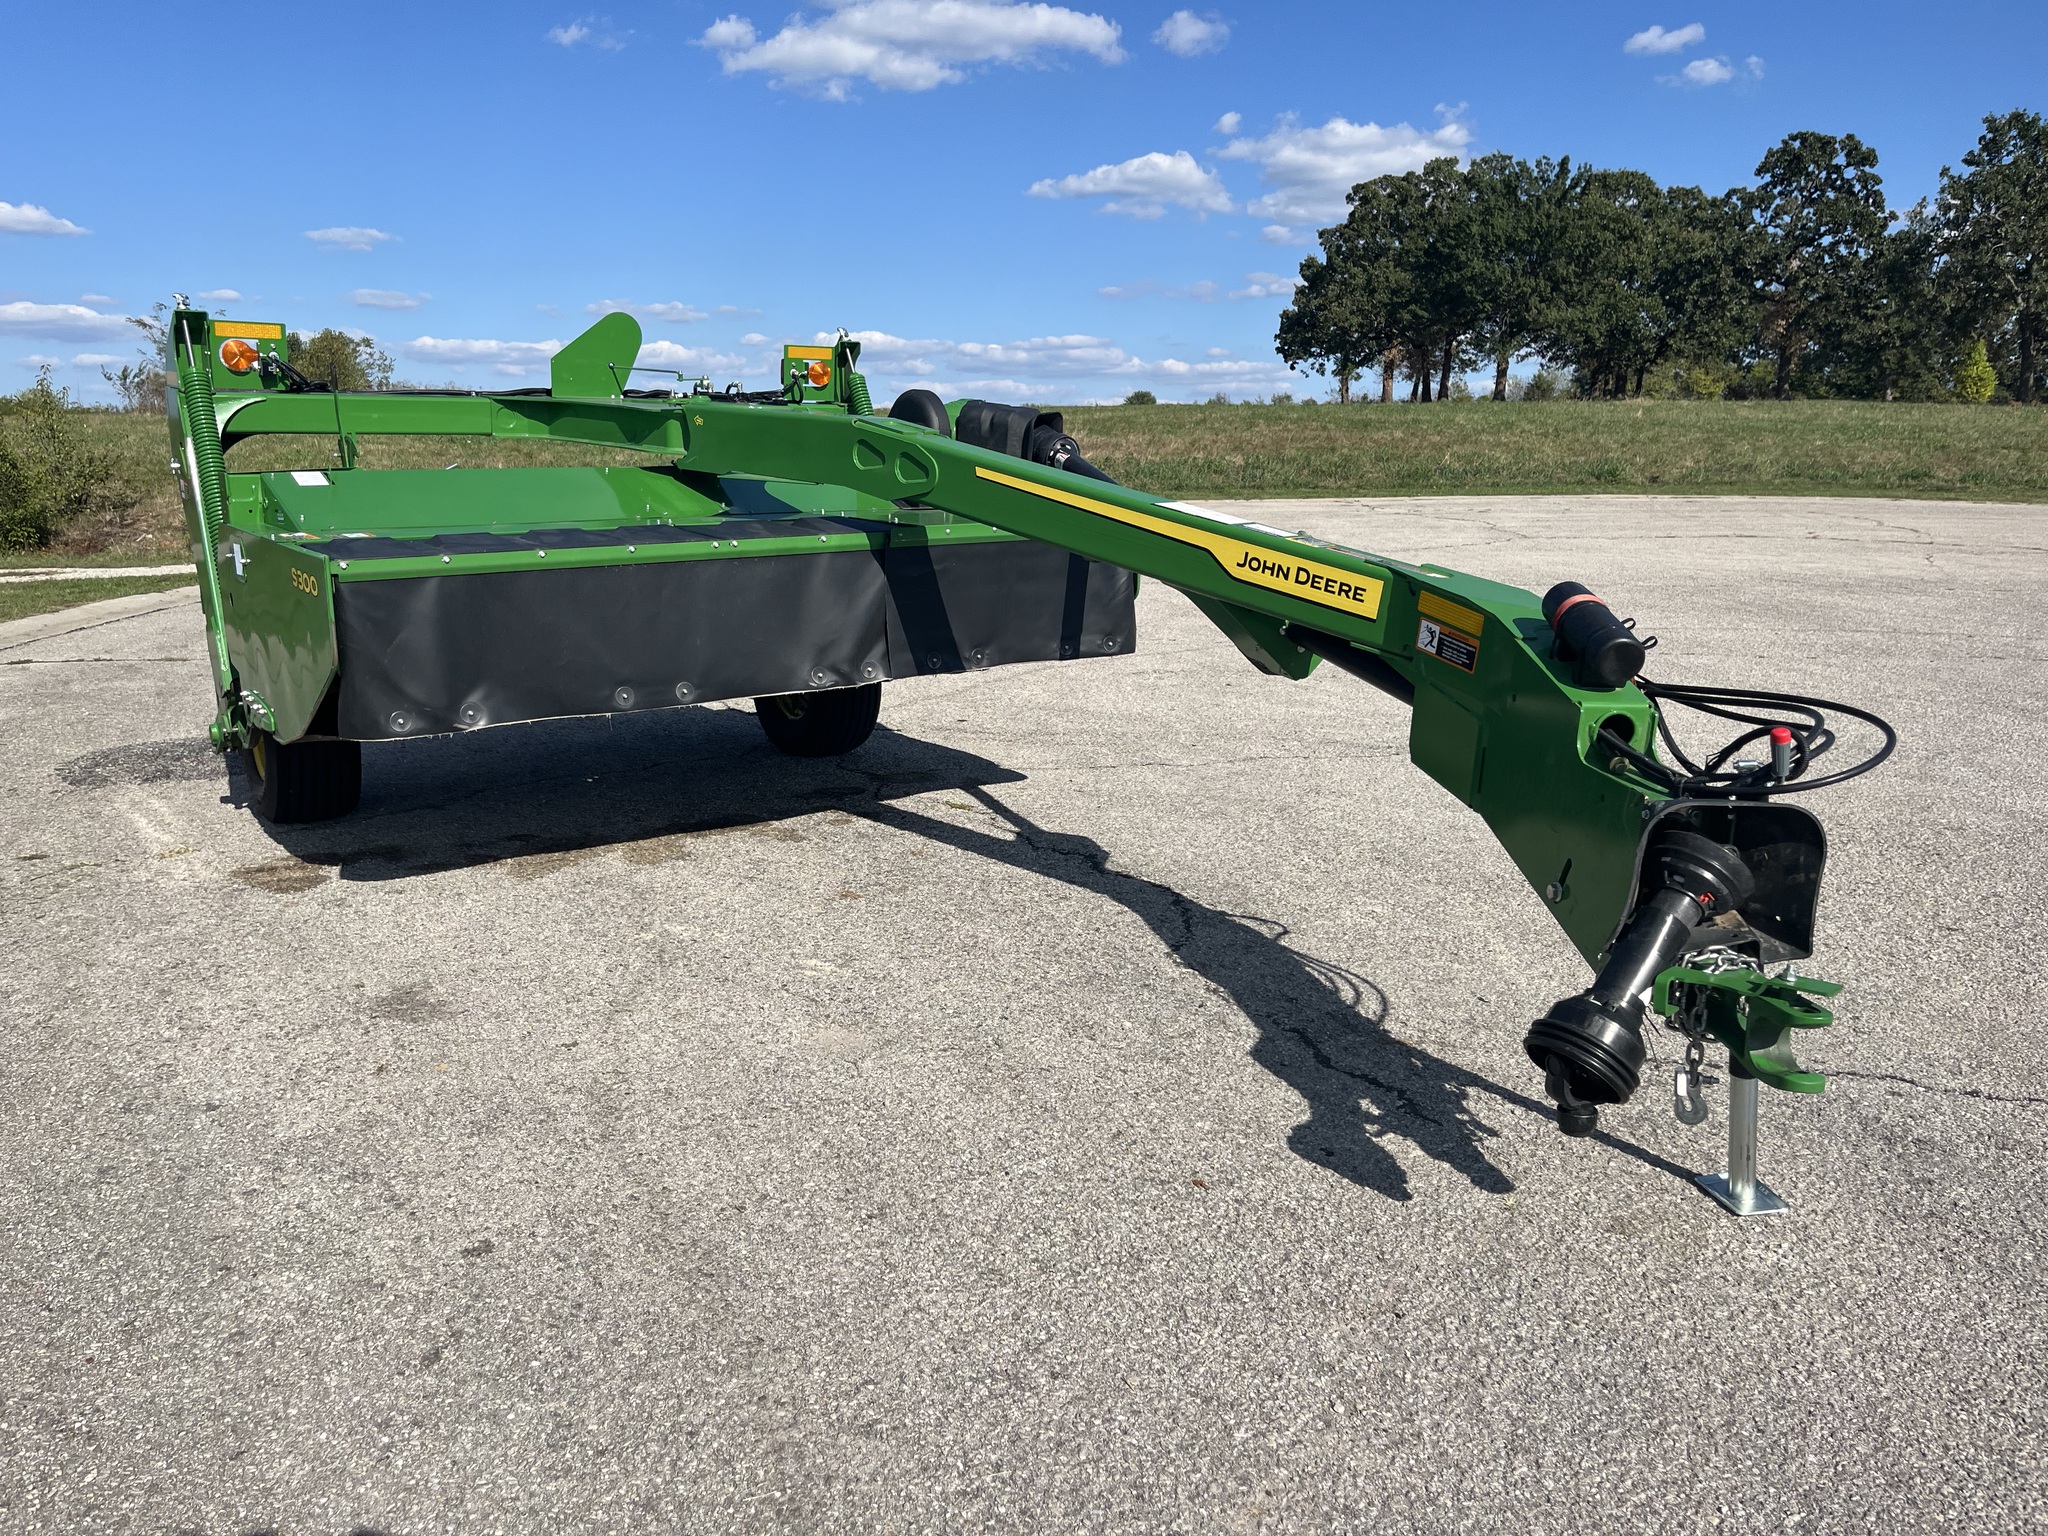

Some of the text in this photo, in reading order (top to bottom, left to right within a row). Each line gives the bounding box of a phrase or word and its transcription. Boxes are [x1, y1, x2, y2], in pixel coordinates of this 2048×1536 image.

[291, 566, 319, 597] S300
[1236, 551, 1291, 581] JOHN
[1294, 566, 1367, 603] DEERE
